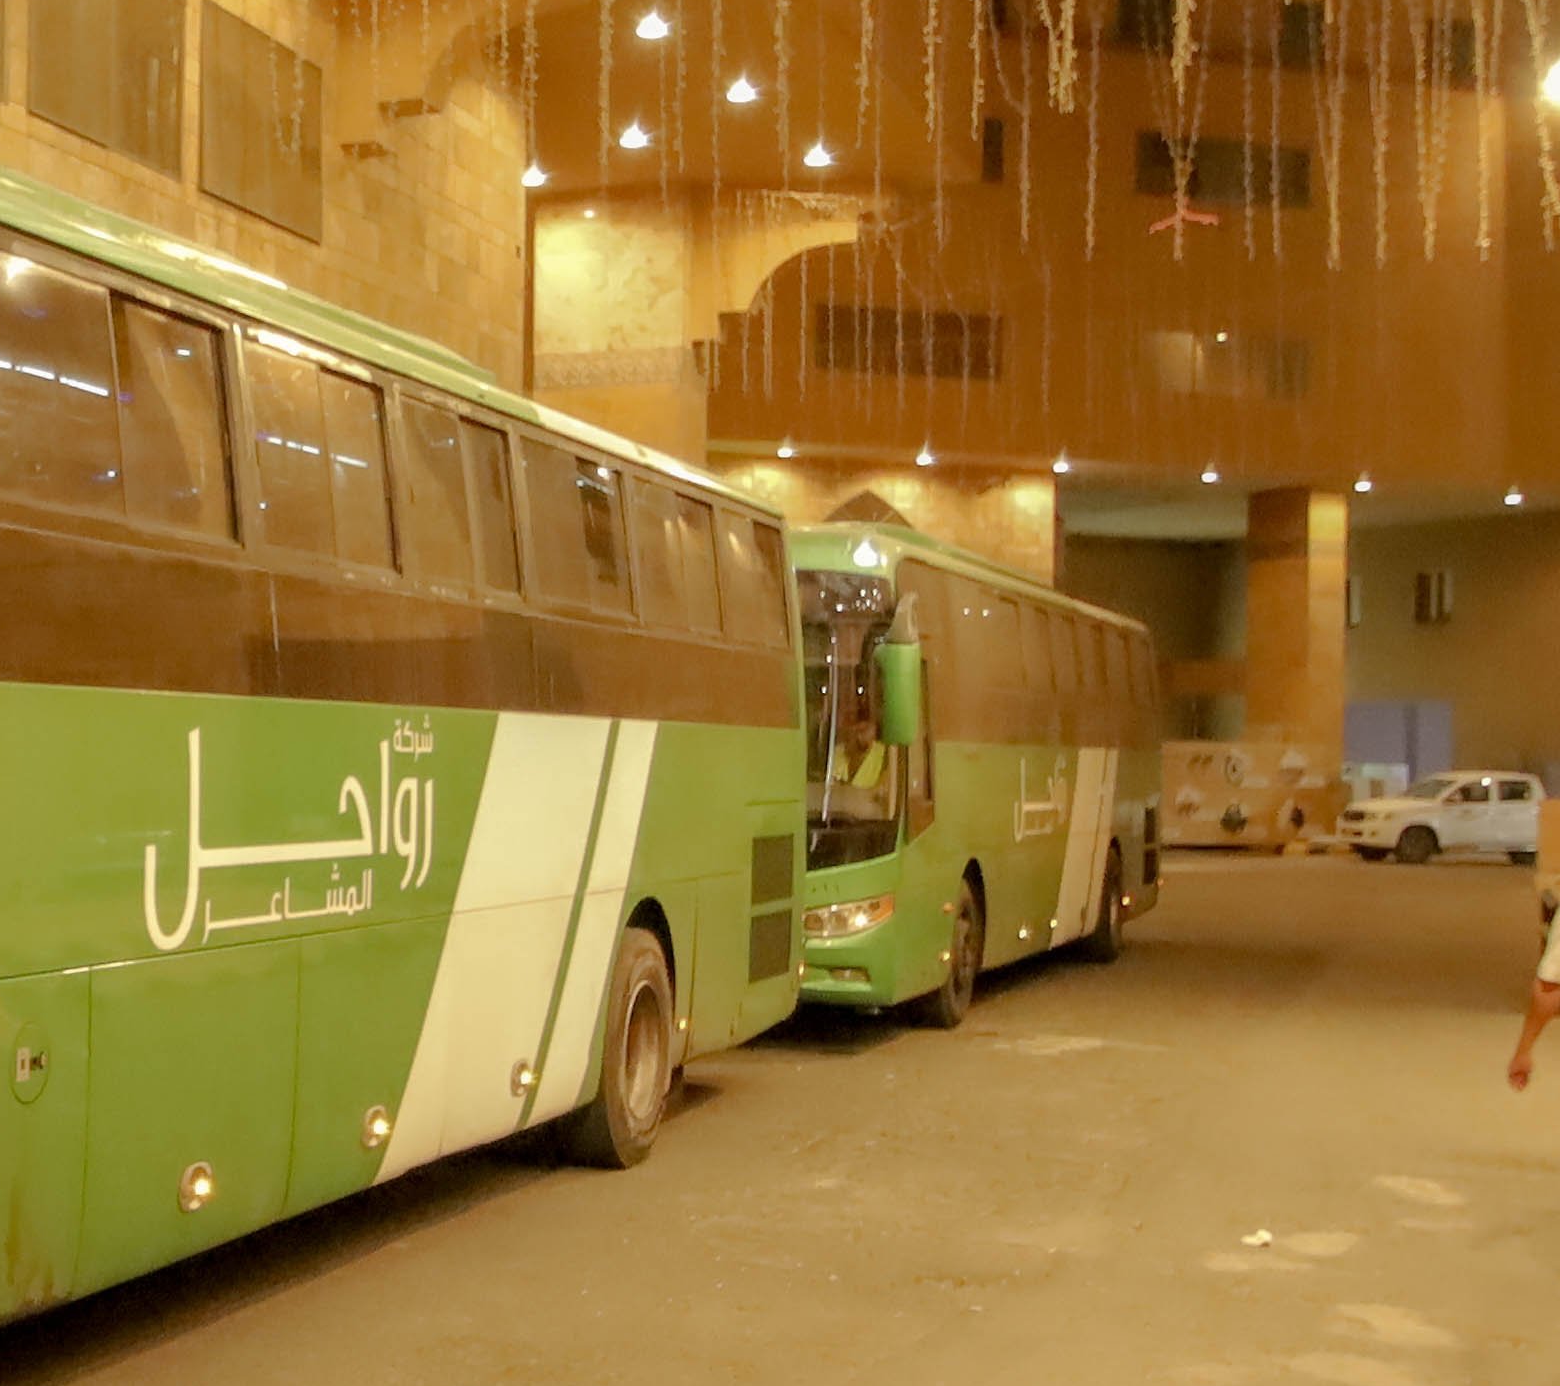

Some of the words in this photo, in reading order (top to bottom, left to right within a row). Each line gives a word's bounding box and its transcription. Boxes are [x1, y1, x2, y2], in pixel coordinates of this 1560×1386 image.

[393, 713, 433, 762] شركة
[144, 726, 434, 950] رواحل
[202, 862, 373, 945] المشاعر
